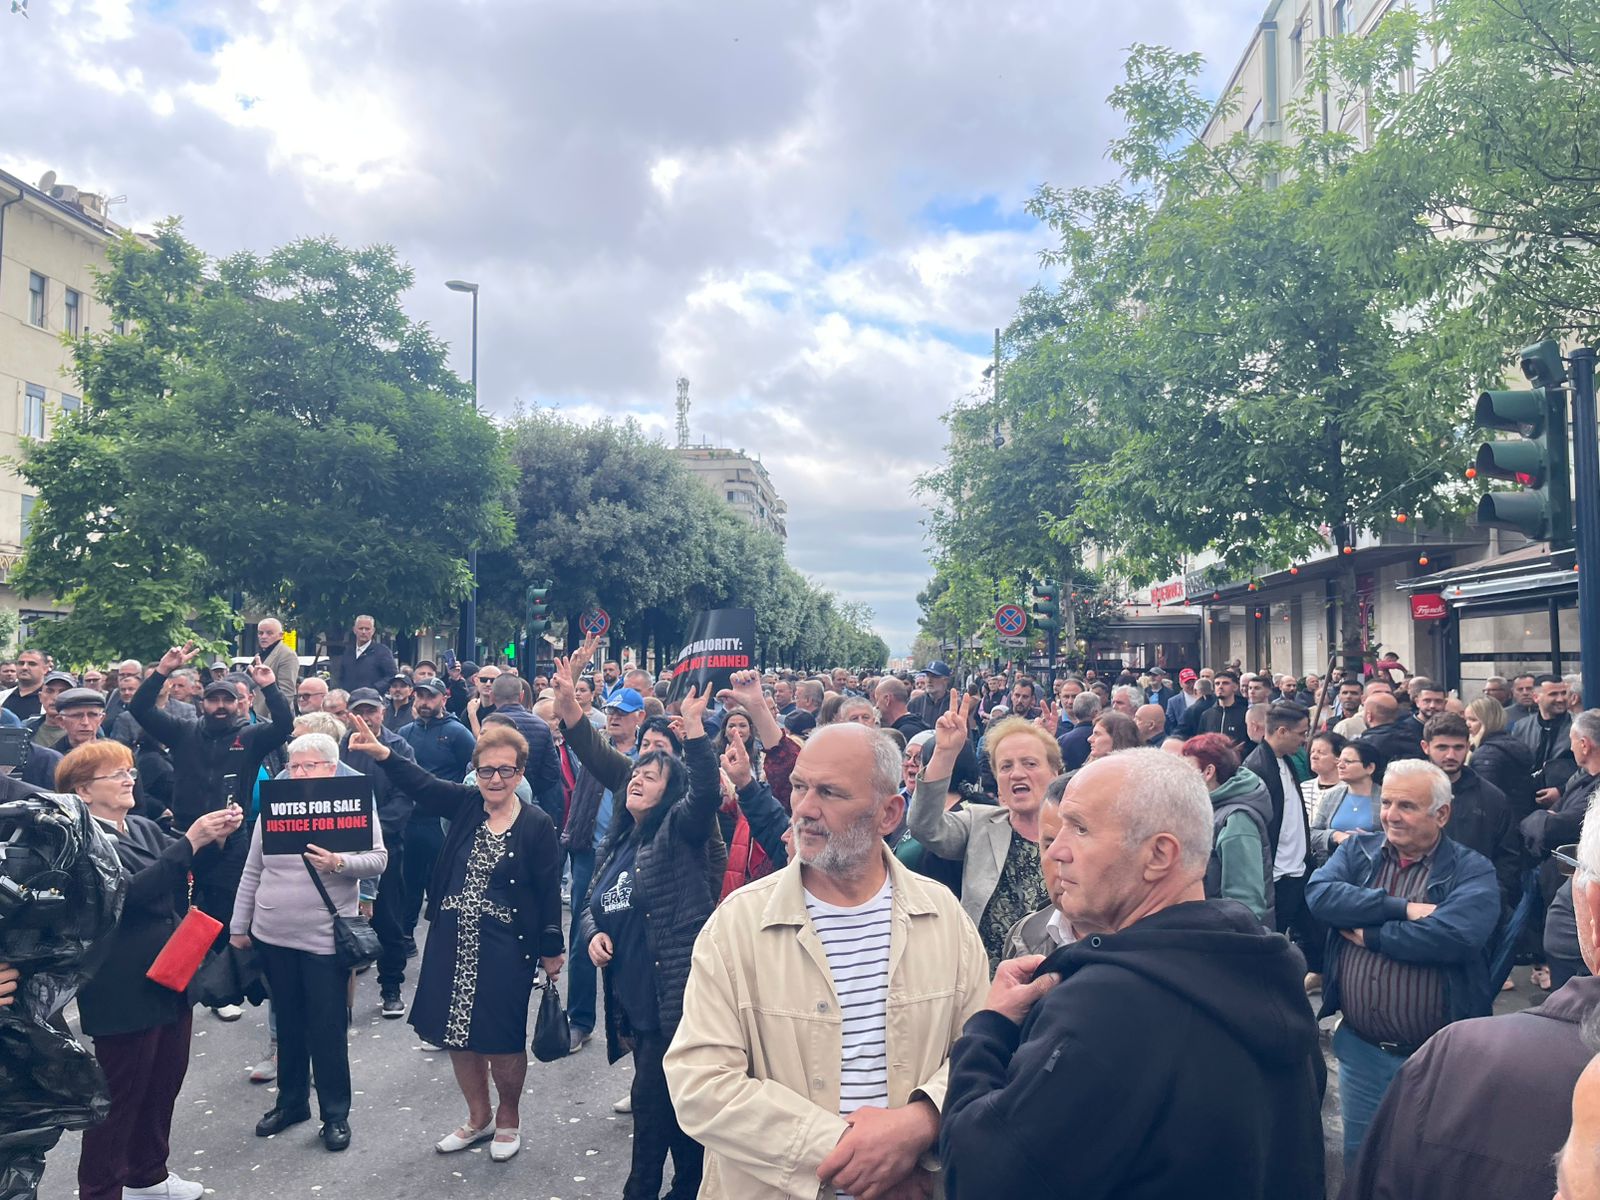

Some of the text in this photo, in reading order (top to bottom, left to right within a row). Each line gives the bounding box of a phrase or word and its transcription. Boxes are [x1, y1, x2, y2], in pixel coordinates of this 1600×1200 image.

[692, 638, 743, 654] MAJORITY:
[707, 655, 749, 668] EARNED
[271, 799, 362, 816] VOTES FOR SALE
[266, 815, 368, 832] JUSTICE FOR NONE
[601, 887, 633, 907] FREE
